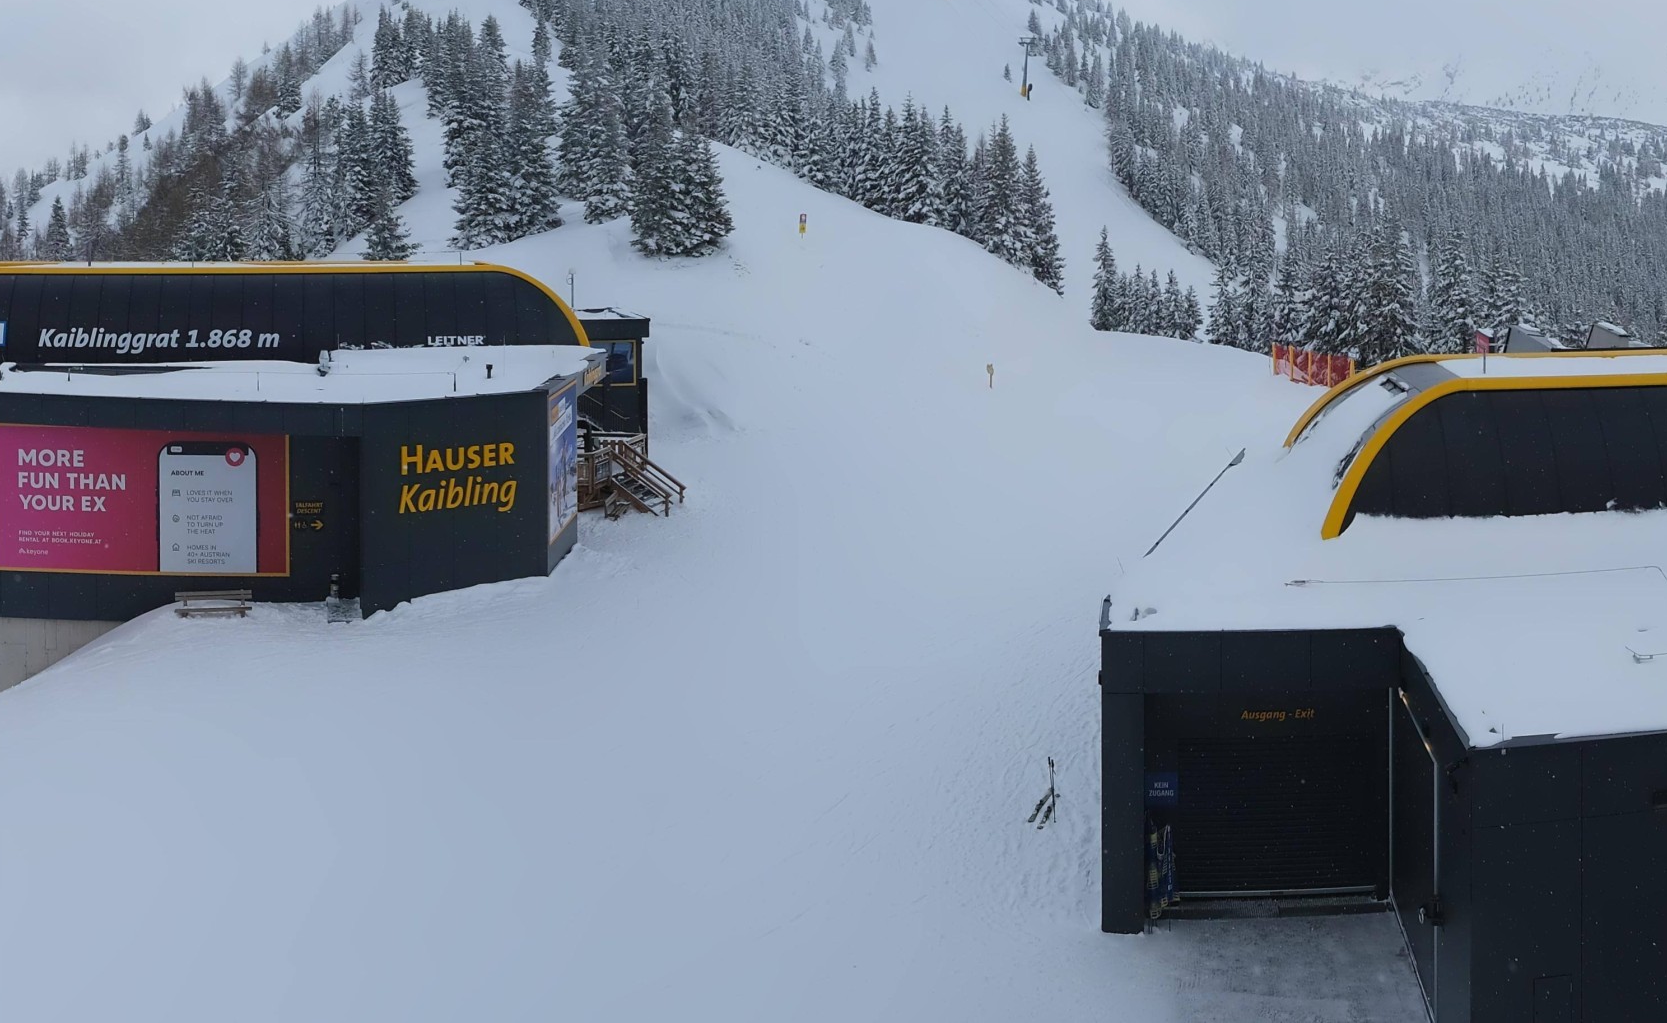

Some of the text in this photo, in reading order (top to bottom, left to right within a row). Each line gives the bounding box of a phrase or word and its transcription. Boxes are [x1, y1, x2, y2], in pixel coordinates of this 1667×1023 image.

[38, 328, 280, 354] Kaiblinggrat 1.868 m
[427, 335, 485, 346] LEITNER
[18, 449, 84, 467] MORE
[401, 442, 516, 476] HAUSER
[18, 471, 126, 491] FUN THAN
[19, 494, 107, 512] YOUR EX
[399, 476, 518, 514] Kaibling
[26, 548, 49, 556] keyone
[1241, 709, 1286, 722] Ausgang
[1295, 708, 1315, 719] Exit
[1149, 789, 1174, 797] ZUGANG
